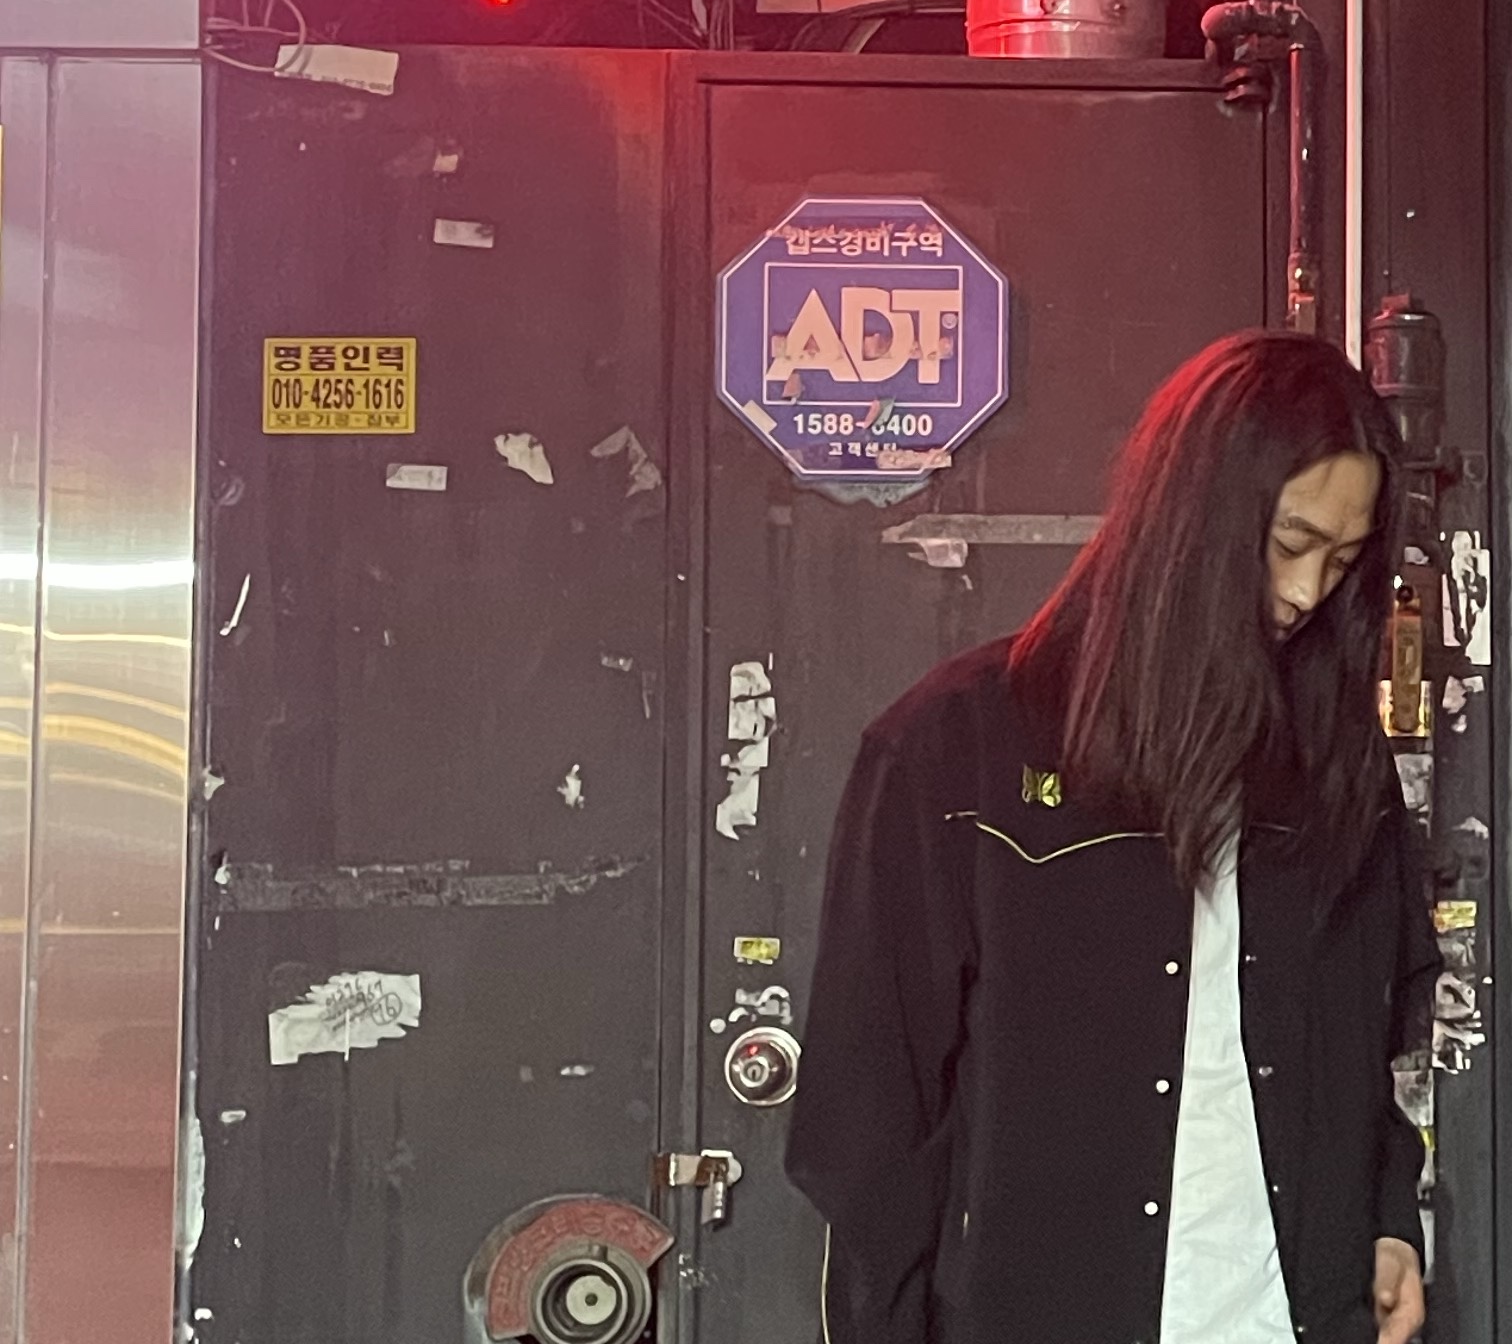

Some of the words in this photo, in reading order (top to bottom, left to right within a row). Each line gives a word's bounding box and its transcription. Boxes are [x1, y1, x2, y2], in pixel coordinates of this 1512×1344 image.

[764, 286, 963, 384] ADT
[273, 345, 404, 372] 명품인력
[272, 378, 405, 409] 010-4256-1616
